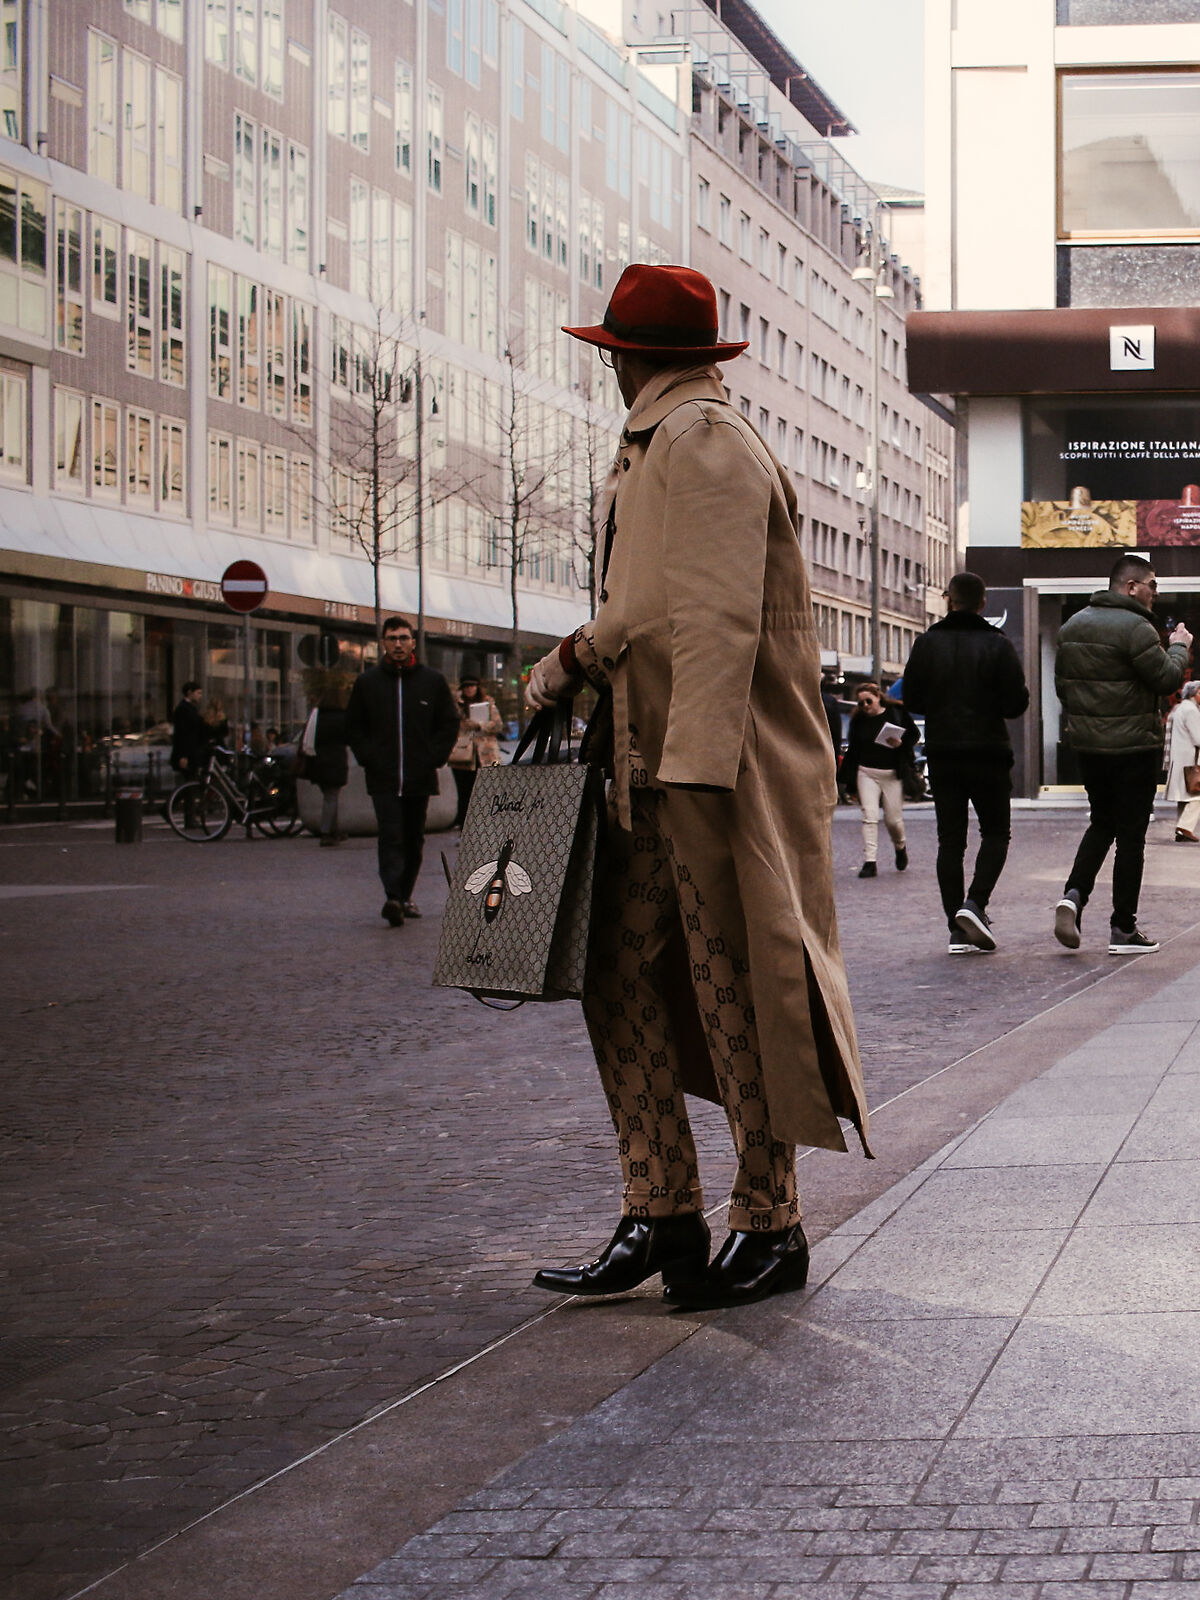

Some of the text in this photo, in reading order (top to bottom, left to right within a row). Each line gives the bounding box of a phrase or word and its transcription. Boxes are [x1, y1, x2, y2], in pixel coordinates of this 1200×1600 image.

[1068, 441, 1145, 450] ISPIRAZIONE
[1125, 450, 1150, 459] CAFFÈ
[1153, 451, 1180, 459] DELLA
[146, 572, 225, 602] PANINO GIUST
[490, 789, 527, 816] Blind
